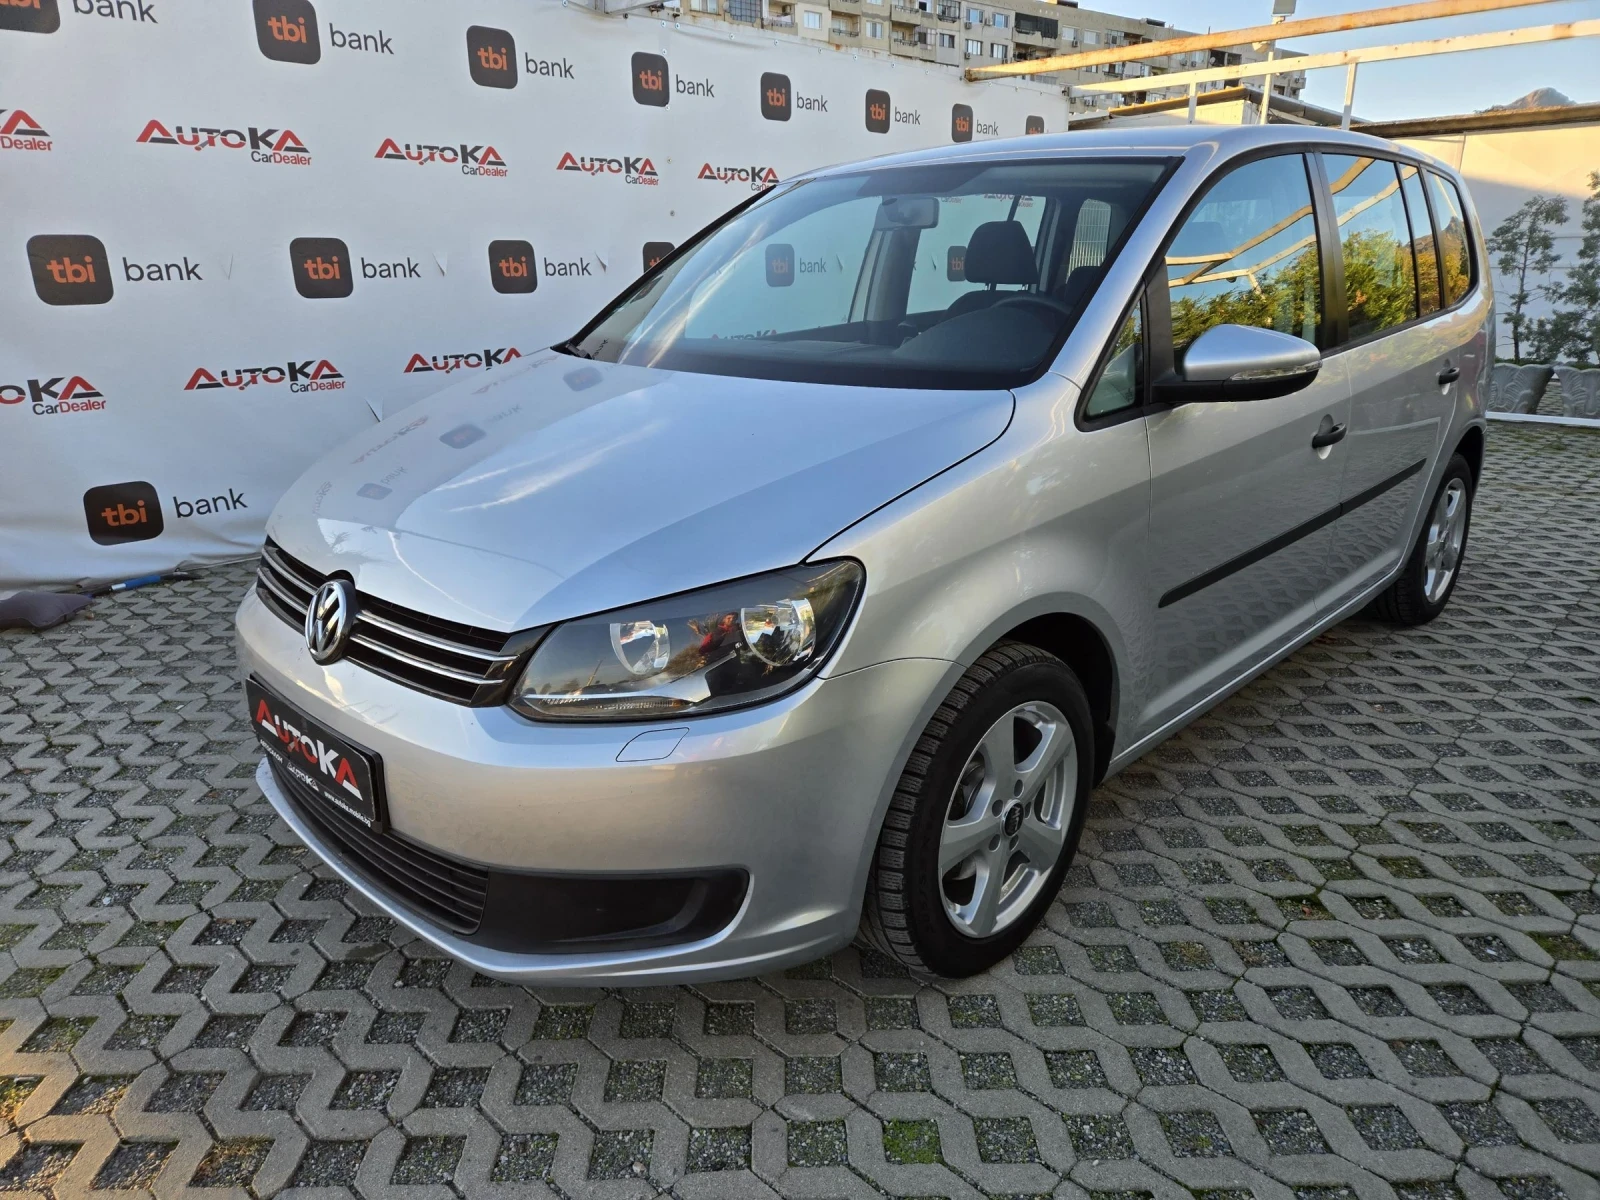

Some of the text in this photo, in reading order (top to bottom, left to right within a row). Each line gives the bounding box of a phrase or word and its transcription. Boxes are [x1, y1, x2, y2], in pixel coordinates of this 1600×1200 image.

[267, 16, 394, 55] tbi bank
[477, 46, 575, 80] tbi bank
[639, 69, 715, 98] tbi bank
[766, 87, 828, 113] tbi bank
[869, 101, 921, 126] tbi bank
[955, 116, 999, 136] tbi bank
[250, 150, 312, 166] CarDealer
[461, 164, 508, 178] CarDealer
[625, 174, 660, 186] CarDealer
[47, 255, 204, 284] tbi bank
[304, 256, 422, 281] tbi bank
[499, 256, 593, 278] tbi bank
[772, 256, 827, 273] tbi bank
[290, 379, 346, 394] CarDealer
[32, 399, 106, 416] CarDealer
[101, 487, 249, 528] tbi bank
